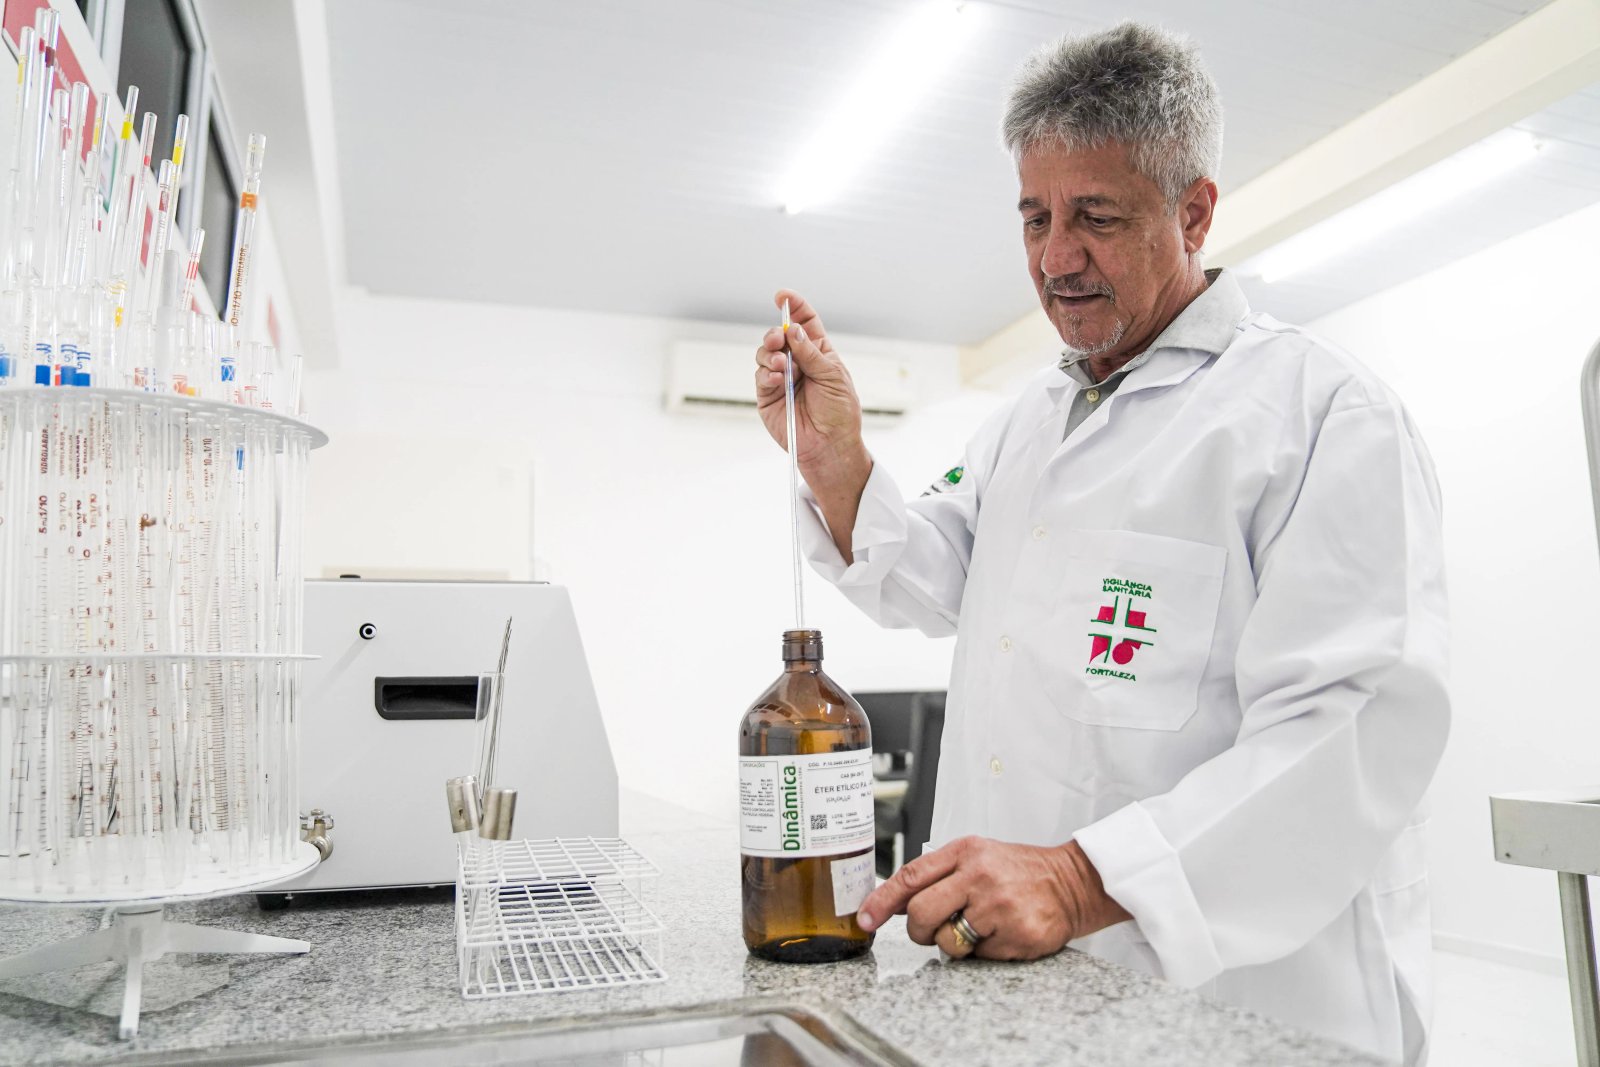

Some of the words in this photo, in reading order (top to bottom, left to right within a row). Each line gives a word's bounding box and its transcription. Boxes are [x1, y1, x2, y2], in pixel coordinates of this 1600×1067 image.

[236, 247, 247, 288] VIDROLABOR
[40, 427, 49, 475] VIDROLABOR
[83, 548, 91, 558] 0
[1102, 578, 1152, 592] VIGILÂNCIA
[1102, 585, 1152, 599] SANITÁRIA
[69, 668, 75, 678] 2
[86, 665, 92, 675] 2
[1086, 667, 1136, 681] FORTALEZA
[151, 673, 156, 682] 5
[814, 784, 835, 794] ÉTER
[836, 782, 860, 792] ETÍLICO
[780, 765, 800, 851] Dinâmica
